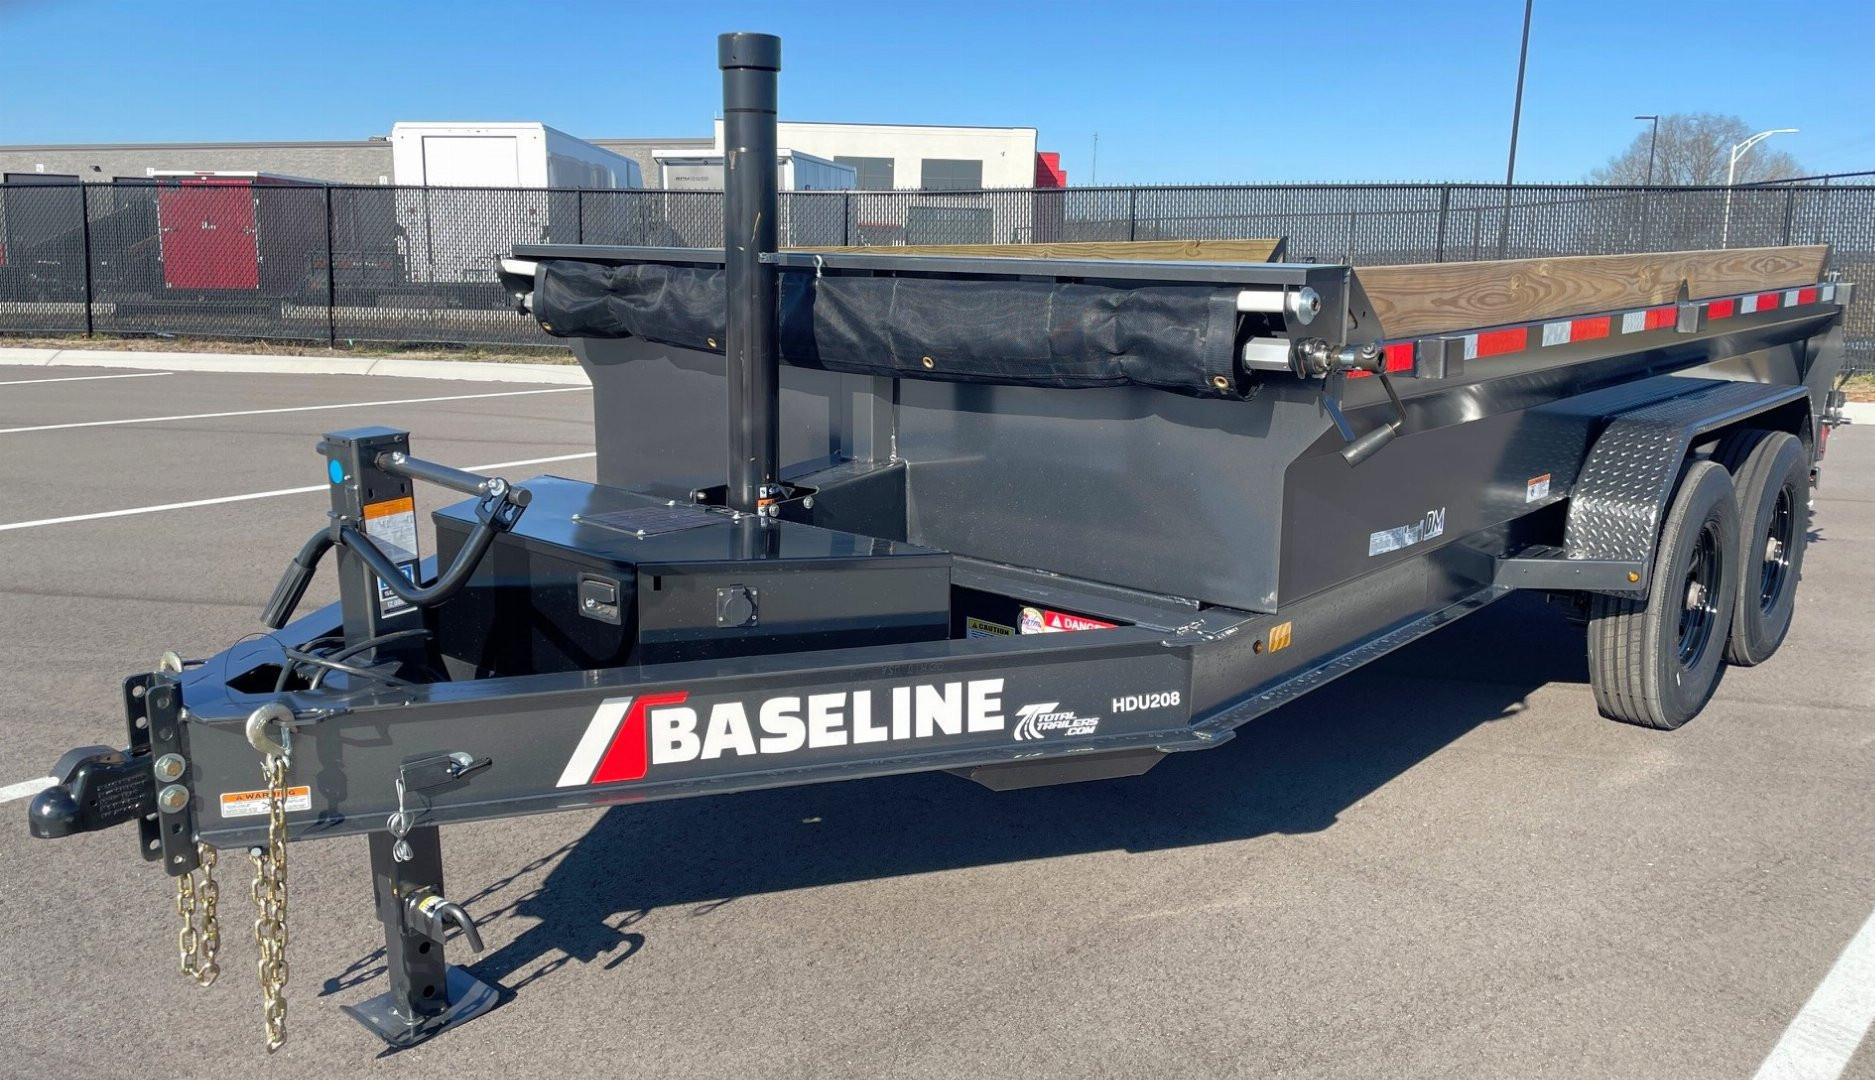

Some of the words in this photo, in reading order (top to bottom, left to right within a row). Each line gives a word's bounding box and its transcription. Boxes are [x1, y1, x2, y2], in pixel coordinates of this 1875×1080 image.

[978, 624, 1010, 636] CAUTION
[1112, 691, 1181, 713] HDU208
[651, 678, 1005, 765] BASELINE
[1037, 711, 1077, 723] TOTAL
[1037, 717, 1100, 731] TRAILERS
[1064, 726, 1096, 736] .COM
